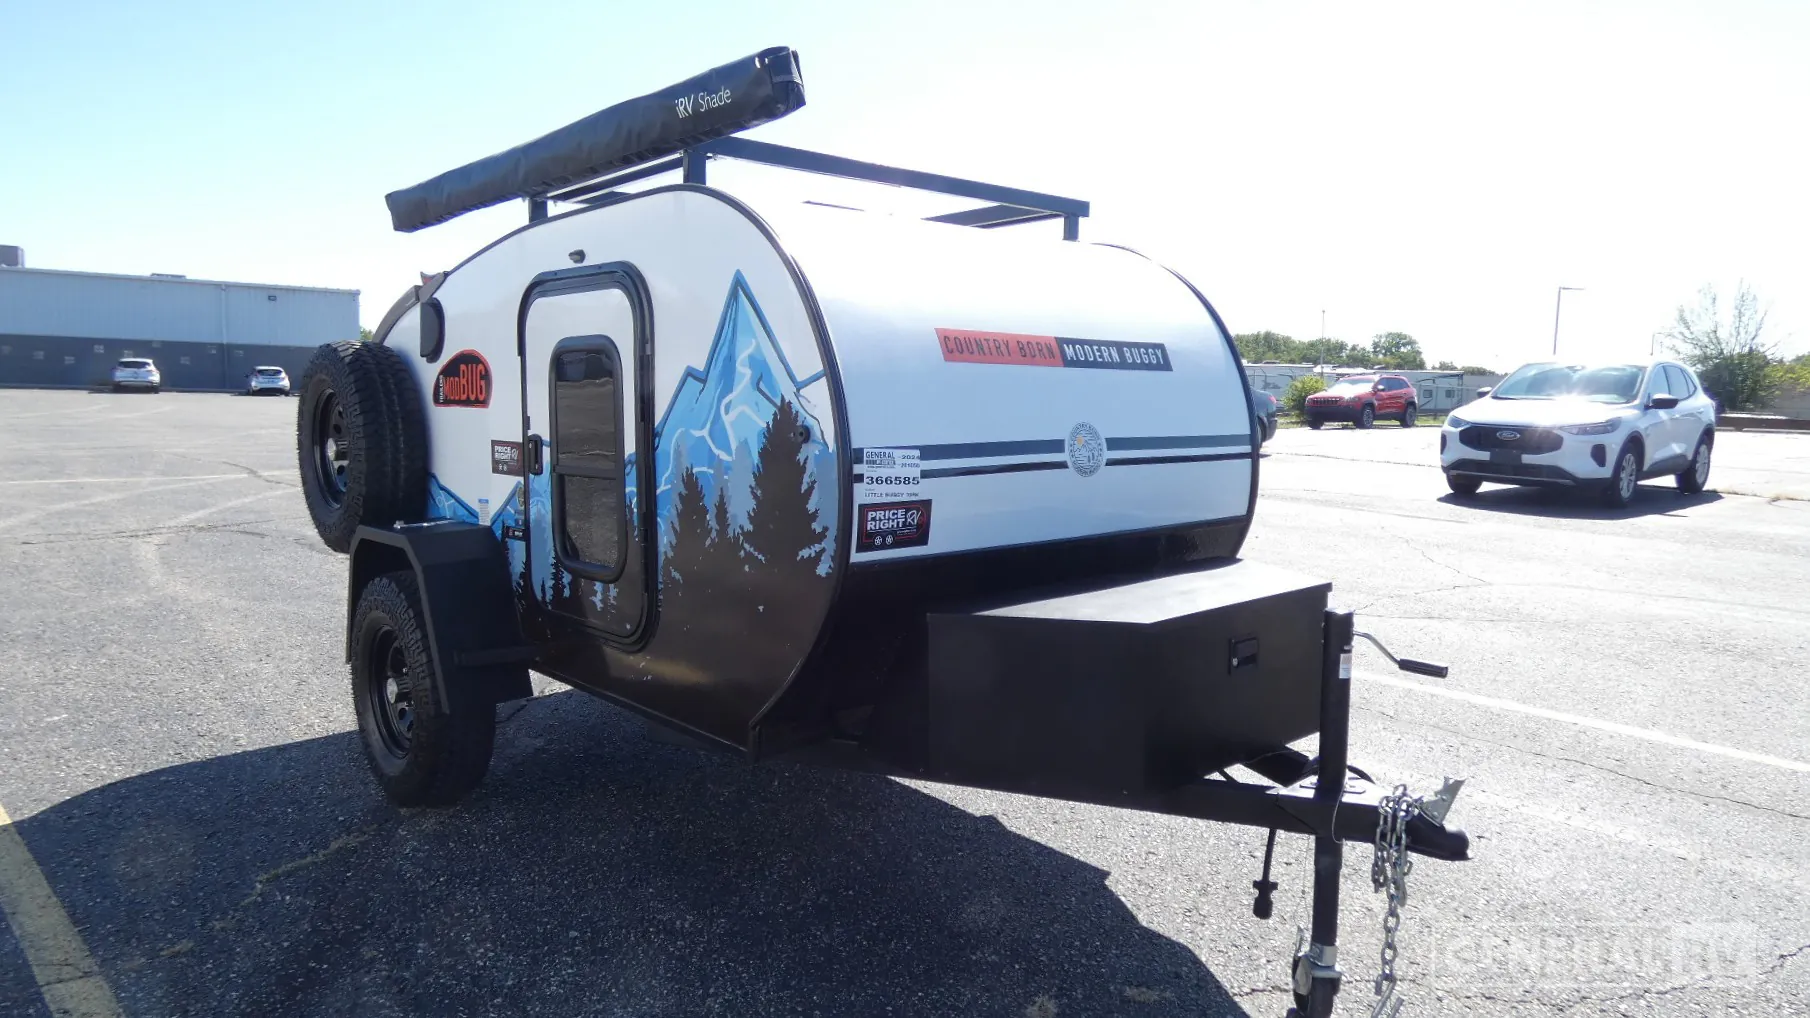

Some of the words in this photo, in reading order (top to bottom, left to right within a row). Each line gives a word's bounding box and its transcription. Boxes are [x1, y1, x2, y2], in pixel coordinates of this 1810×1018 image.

[674, 94, 695, 119] iRV
[698, 85, 732, 112] Shade
[943, 335, 1012, 357] COUNTRY
[1017, 340, 1056, 360] BORN
[1063, 343, 1120, 363] MODERN
[1125, 347, 1165, 365] BUGGY
[494, 445, 512, 454] PRICE
[865, 451, 896, 460] GENERAL
[494, 452, 512, 461] RIGHT
[865, 476, 920, 486] 366585
[867, 509, 906, 521] PRICE
[867, 519, 906, 531] RIGHT
